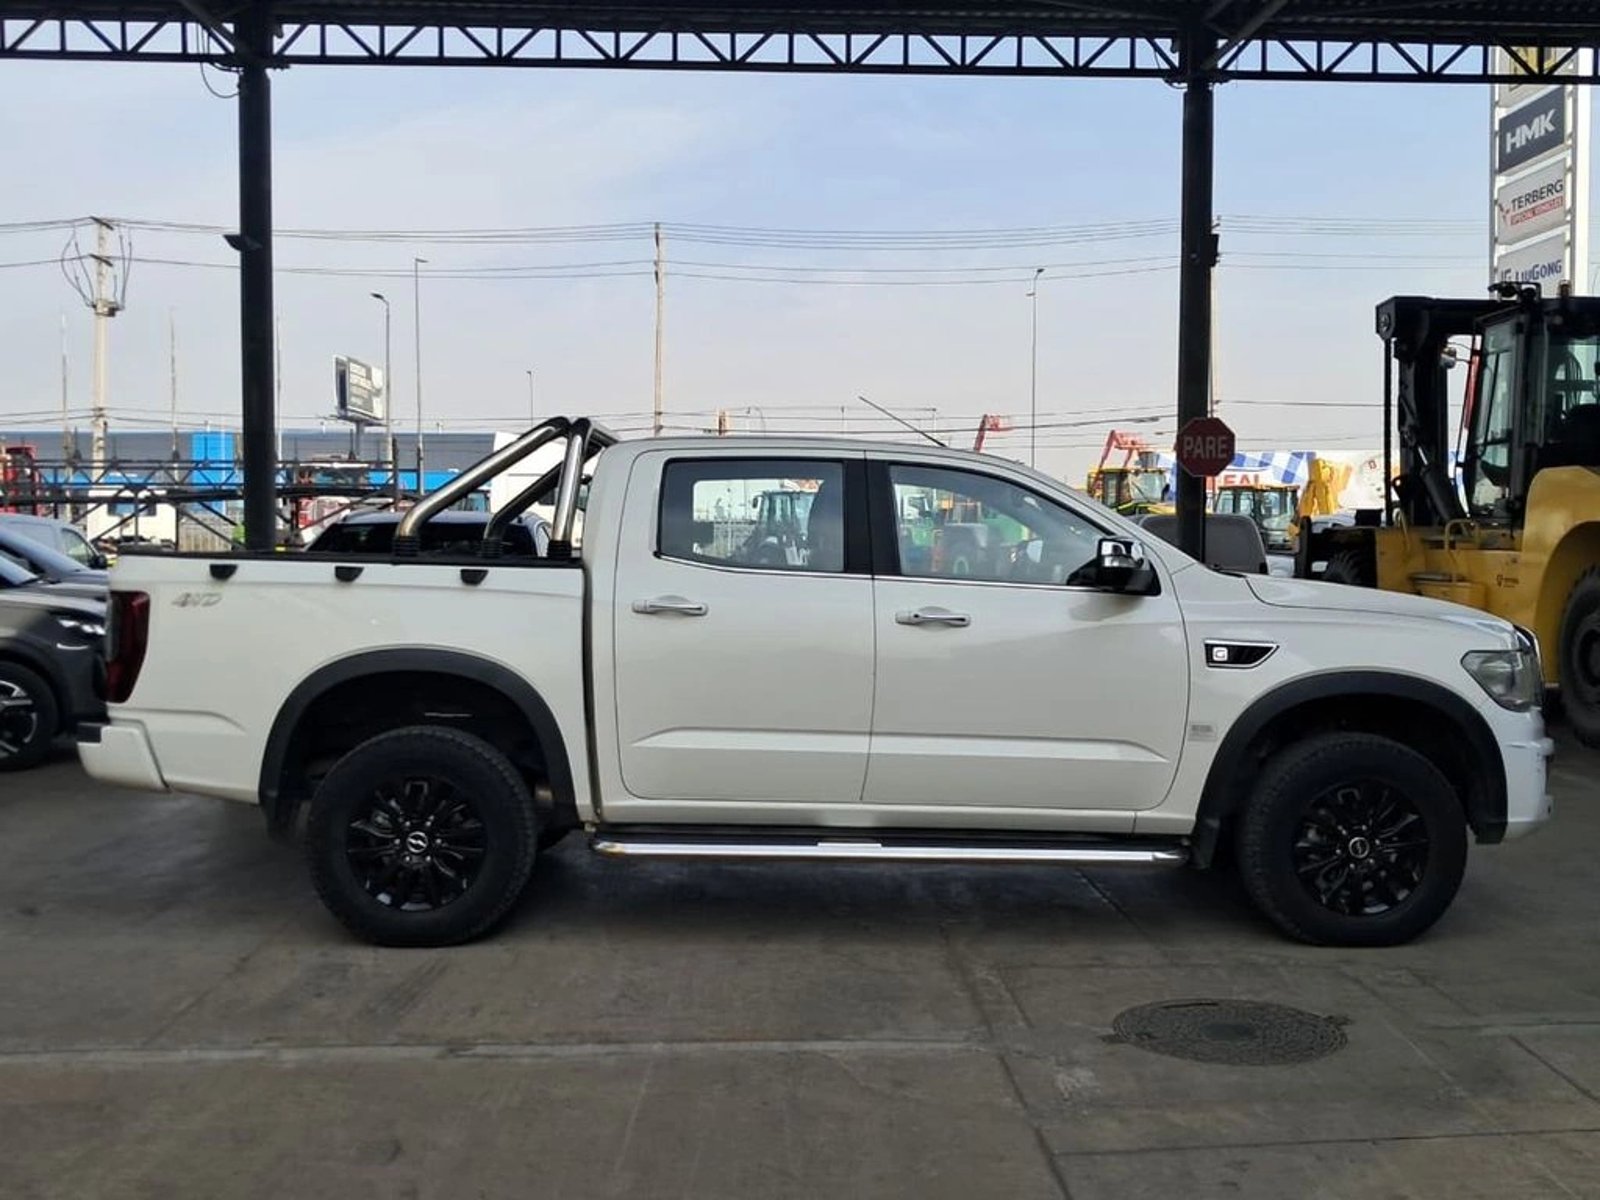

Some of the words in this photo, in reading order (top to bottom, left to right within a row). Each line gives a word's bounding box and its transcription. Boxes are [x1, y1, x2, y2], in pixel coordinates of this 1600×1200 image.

[1506, 108, 1556, 154] HMK
[1511, 179, 1564, 211] TERBERG
[1182, 435, 1228, 459] PARE
